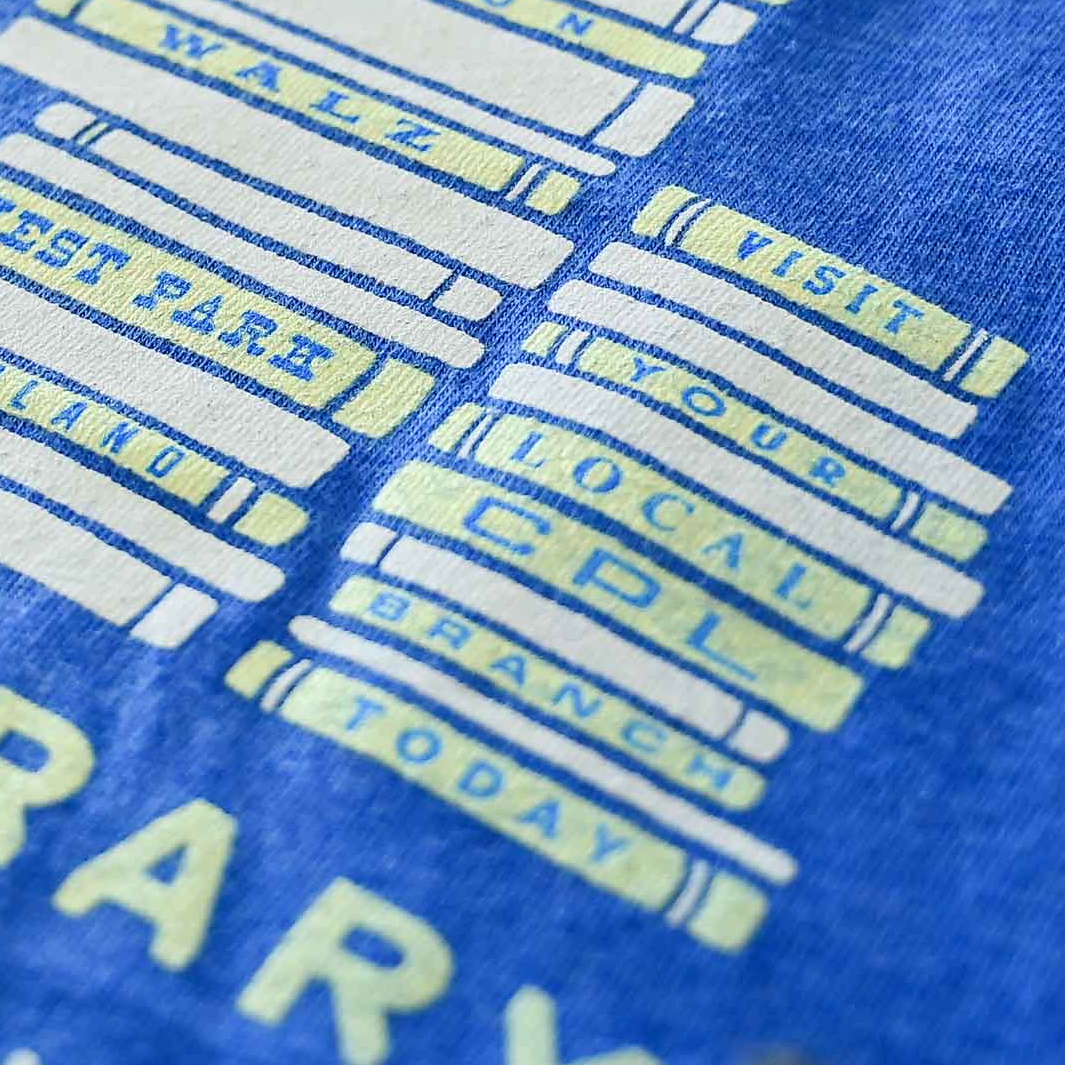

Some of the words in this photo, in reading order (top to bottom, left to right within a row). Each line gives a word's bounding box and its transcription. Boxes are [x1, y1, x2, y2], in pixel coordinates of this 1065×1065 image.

[159, 23, 441, 152] WALZ
[131, 271, 337, 383] PARK
[738, 229, 925, 338] VISIT
[630, 357, 848, 489] YOUR
[463, 495, 758, 683] CPL
[510, 429, 824, 612] LOCAL
[368, 591, 736, 792] BRANCH
[339, 697, 635, 865] TODAY
